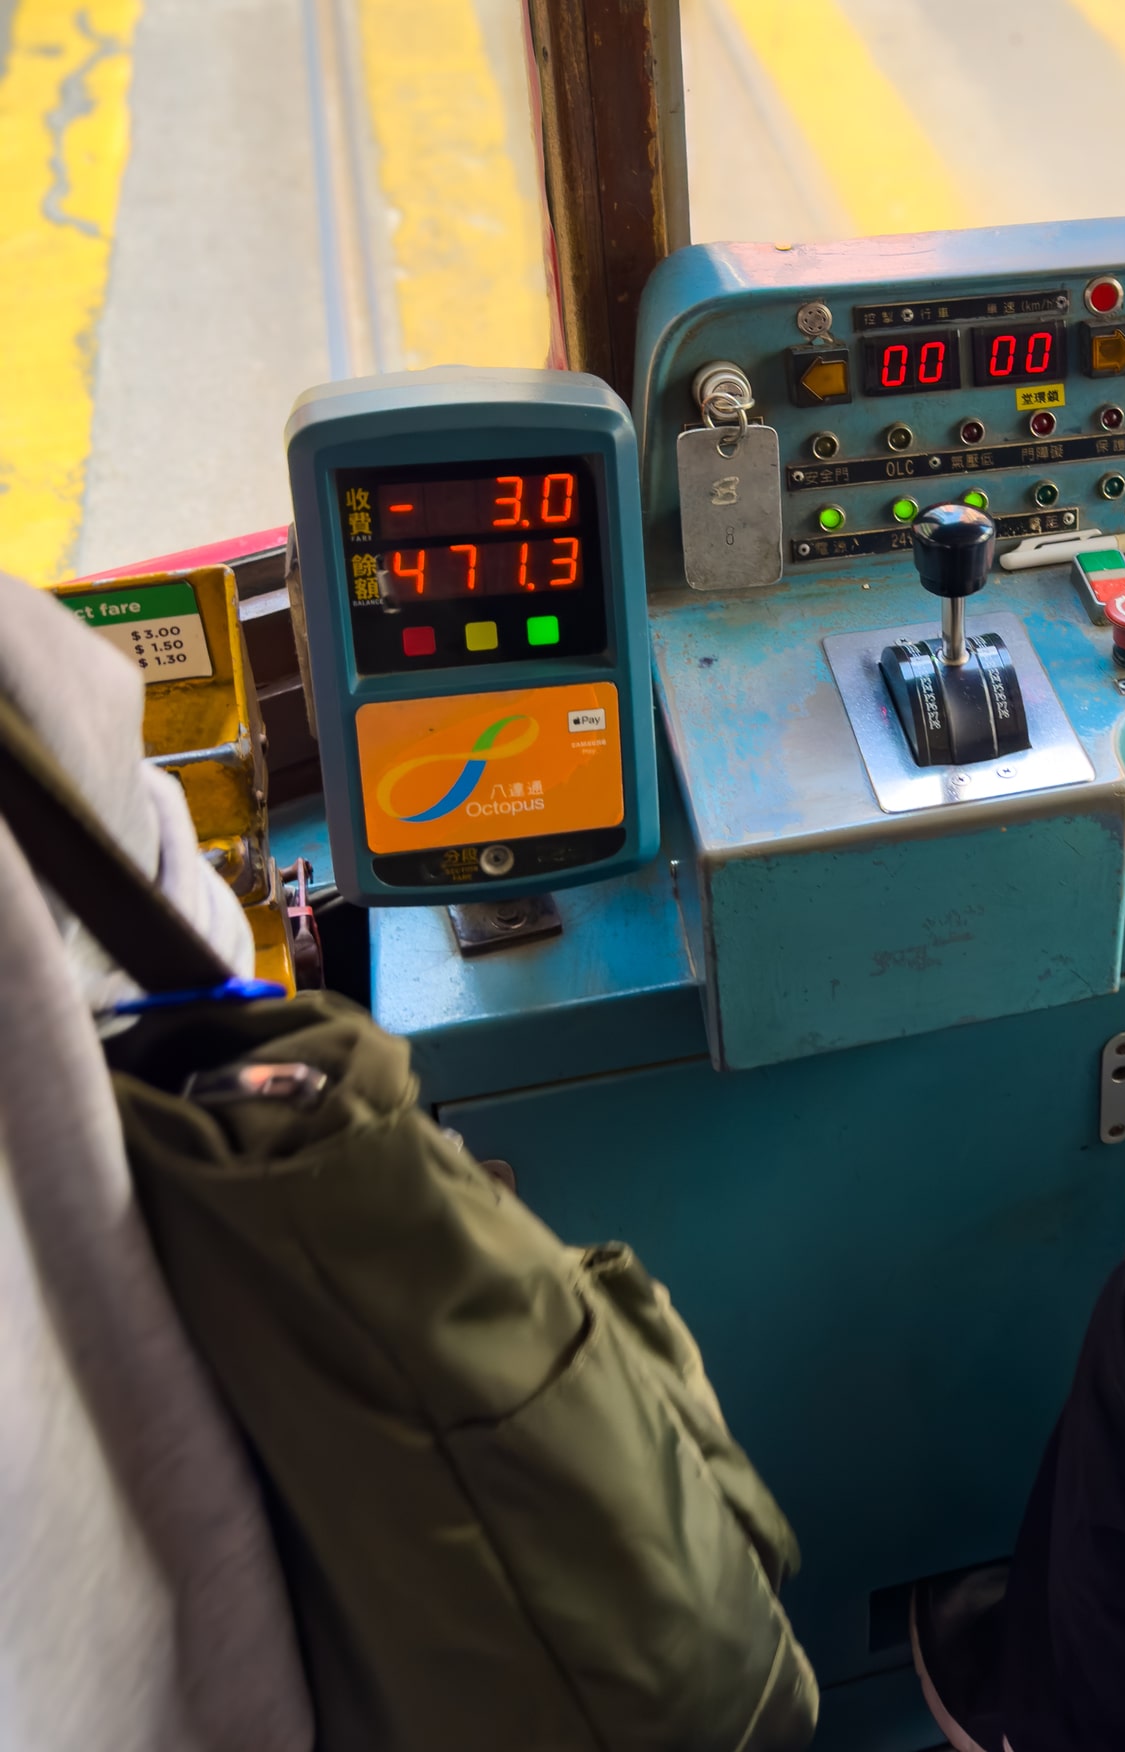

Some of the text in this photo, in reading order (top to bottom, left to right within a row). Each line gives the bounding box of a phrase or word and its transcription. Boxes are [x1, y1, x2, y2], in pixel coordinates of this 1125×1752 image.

[881, 332, 1053, 387] 00 00
[804, 467, 849, 485] 安全門
[886, 459, 915, 477] OLC
[346, 487, 373, 535] 收費
[493, 473, 574, 529] 3.0
[352, 553, 382, 600] 餘額
[393, 537, 579, 594] 471.3
[99, 602, 141, 617] fare
[465, 797, 545, 818] Octopus
[490, 779, 544, 800] 八達通
